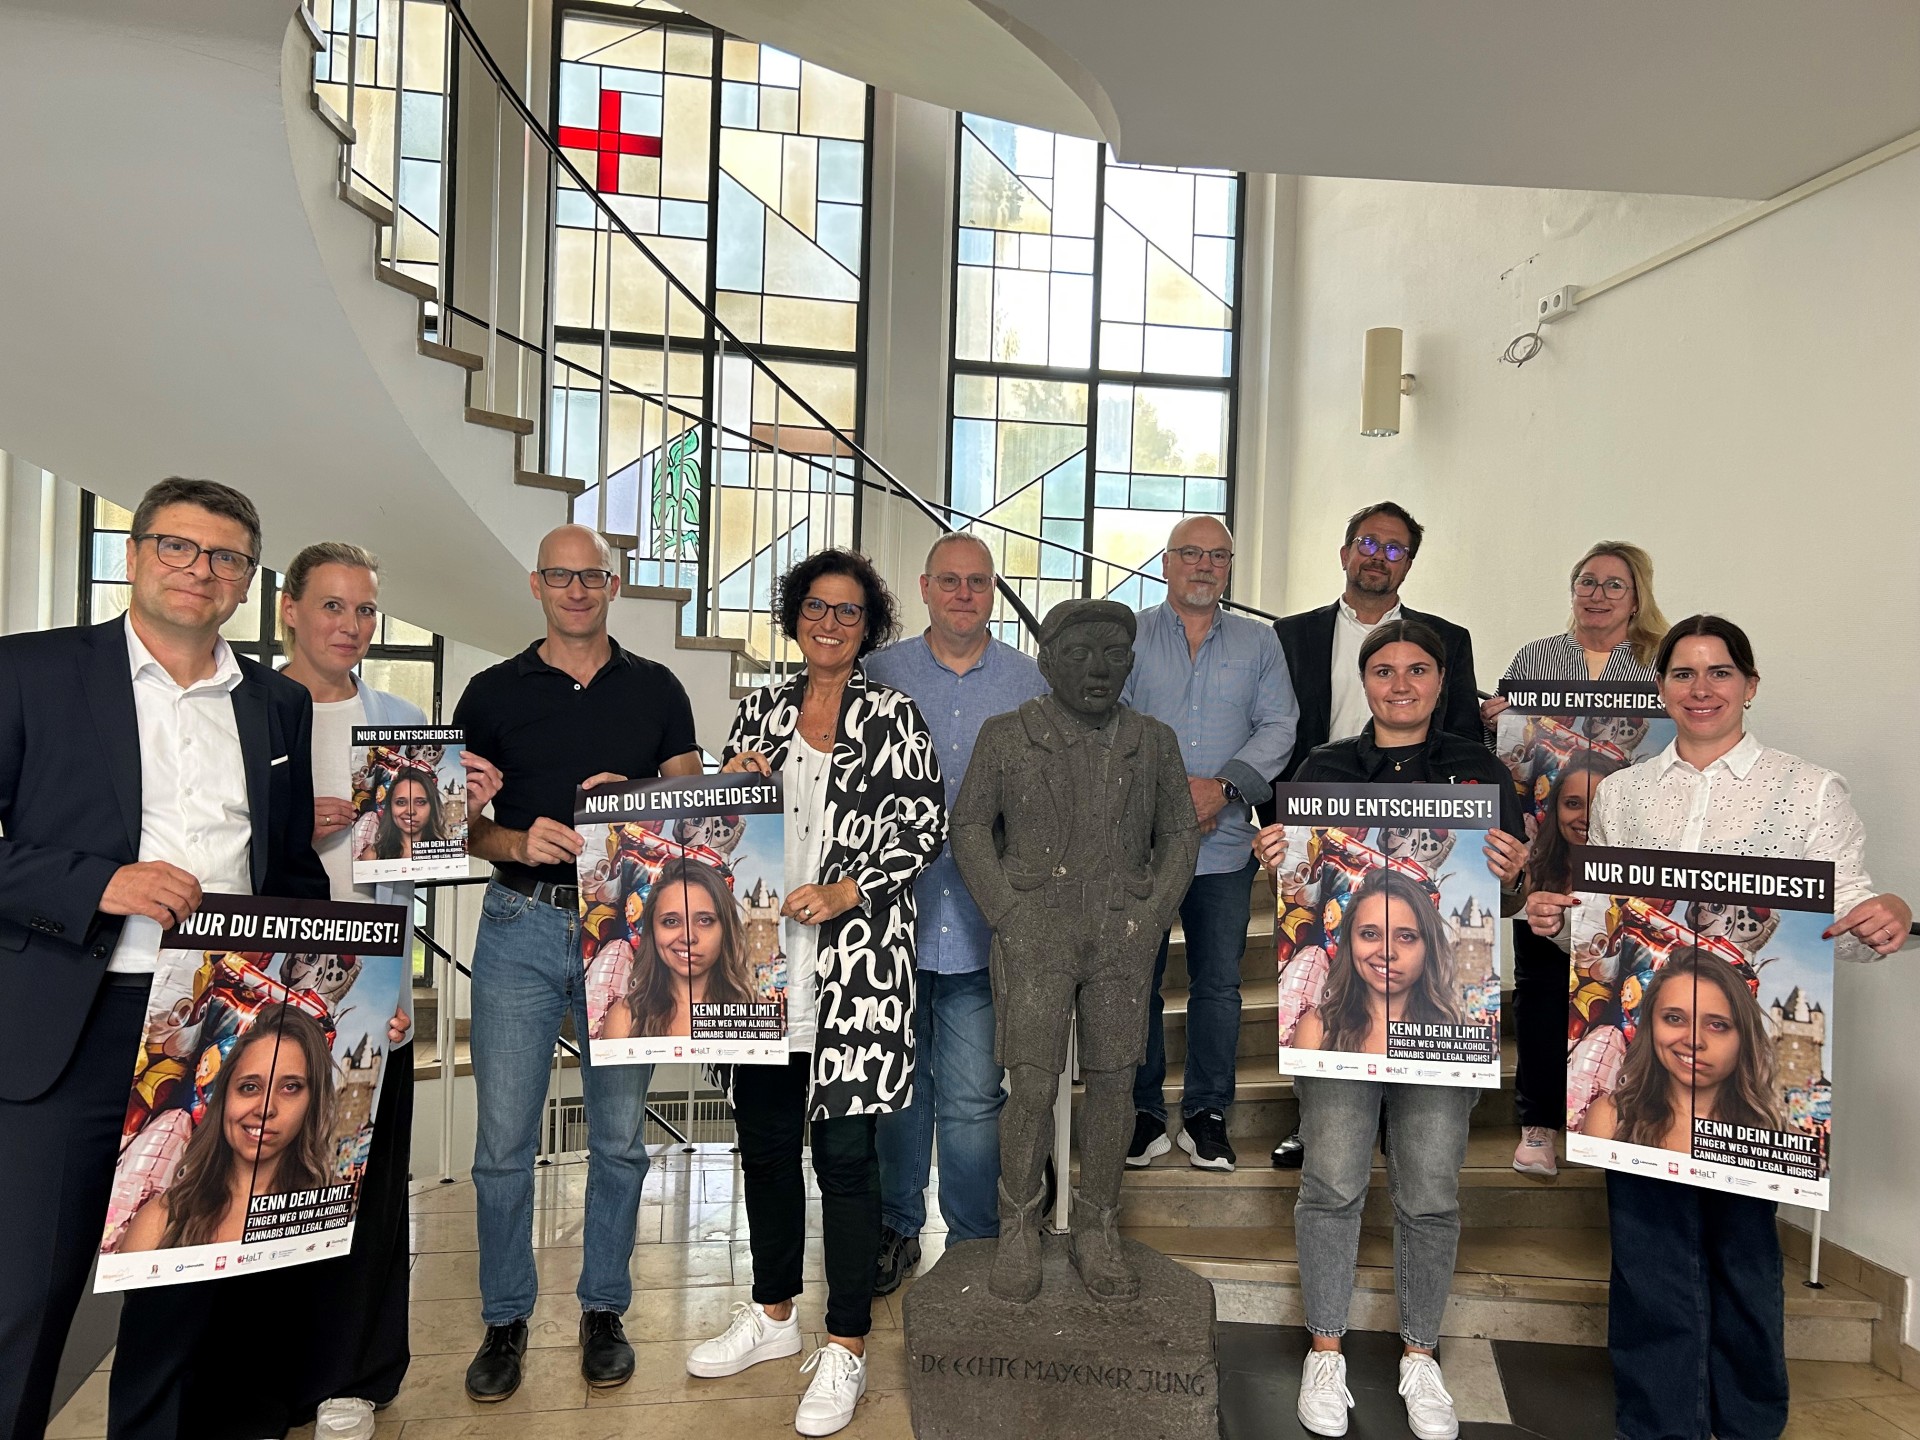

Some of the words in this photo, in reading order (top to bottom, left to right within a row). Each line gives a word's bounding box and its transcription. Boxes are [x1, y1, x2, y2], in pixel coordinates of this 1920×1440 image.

[1508, 691, 1537, 707] NUR
[1541, 692, 1560, 707] DU
[1565, 693, 1666, 709] ENTSCHEIDES
[357, 731, 376, 741] NUR
[379, 730, 391, 741] DU
[394, 729, 464, 741] ENTSCHEIDEST!
[585, 795, 619, 814] NUR
[624, 794, 646, 812] DU
[650, 785, 777, 811] ENTSCHEIDEST!
[1288, 797, 1323, 816] NUR
[1327, 798, 1350, 817] DU
[1355, 798, 1492, 819] ENTSCHEIDEST!
[412, 841, 430, 849] KENN
[1583, 861, 1623, 884] NUR
[1629, 864, 1654, 887] DU
[1661, 867, 1826, 900] ENTSCHEIDEST!
[179, 912, 223, 937] NUR
[230, 914, 257, 937] DU
[262, 915, 399, 944] ENTSCHEIDEST!
[692, 1003, 721, 1017] KENN
[723, 1003, 747, 1017] DEIN
[749, 1003, 779, 1017] LIMIT.
[692, 1019, 716, 1028] FINGER
[718, 1019, 732, 1028] WEG
[733, 1019, 747, 1028] VON
[1389, 1022, 1421, 1037] KENN
[1424, 1024, 1452, 1038] DEIN
[1455, 1025, 1490, 1040] LIMIT.
[692, 1030, 724, 1039] CANNABIS
[725, 1030, 738, 1039] UND
[739, 1030, 758, 1039] LEGAL
[759, 1030, 780, 1039] HIGHS!
[1389, 1038, 1416, 1048] FINGER
[1418, 1040, 1434, 1049] WEG
[1436, 1041, 1452, 1050] VON
[1389, 1050, 1424, 1060] CANNABIS
[1426, 1051, 1441, 1061] UND
[1443, 1052, 1465, 1062] LEGAL
[1466, 1053, 1490, 1063] HIGHS!
[1694, 1119, 1733, 1138] KENN
[1736, 1126, 1770, 1145] DEIN
[1773, 1132, 1817, 1153] LIMIT.
[1694, 1138, 1726, 1151] FINGER
[1728, 1142, 1748, 1154] WEG
[1750, 1145, 1770, 1158] VON
[1771, 1149, 1817, 1167] ALKOHOL,
[1693, 1150, 1736, 1165] CANNABIS
[1737, 1157, 1756, 1168] UND
[1757, 1161, 1786, 1174] LEGAL
[1787, 1165, 1817, 1179] HIGHS!
[250, 1194, 286, 1213] KENN
[289, 1189, 317, 1207] DEIN
[320, 1184, 352, 1203] LIMIT.
[247, 1214, 277, 1228] FINGER
[279, 1211, 297, 1223] WEG
[299, 1208, 314, 1221] VON
[244, 1226, 283, 1242] CANNABIS
[284, 1223, 300, 1236] UND
[301, 1221, 323, 1234] LEGAL
[324, 1218, 347, 1231] HIGHS!
[921, 1354, 946, 1374] DE
[953, 1355, 1018, 1380] ECHTE
[1024, 1359, 1132, 1390] MAYENER
[1137, 1369, 1206, 1397] JUNG
